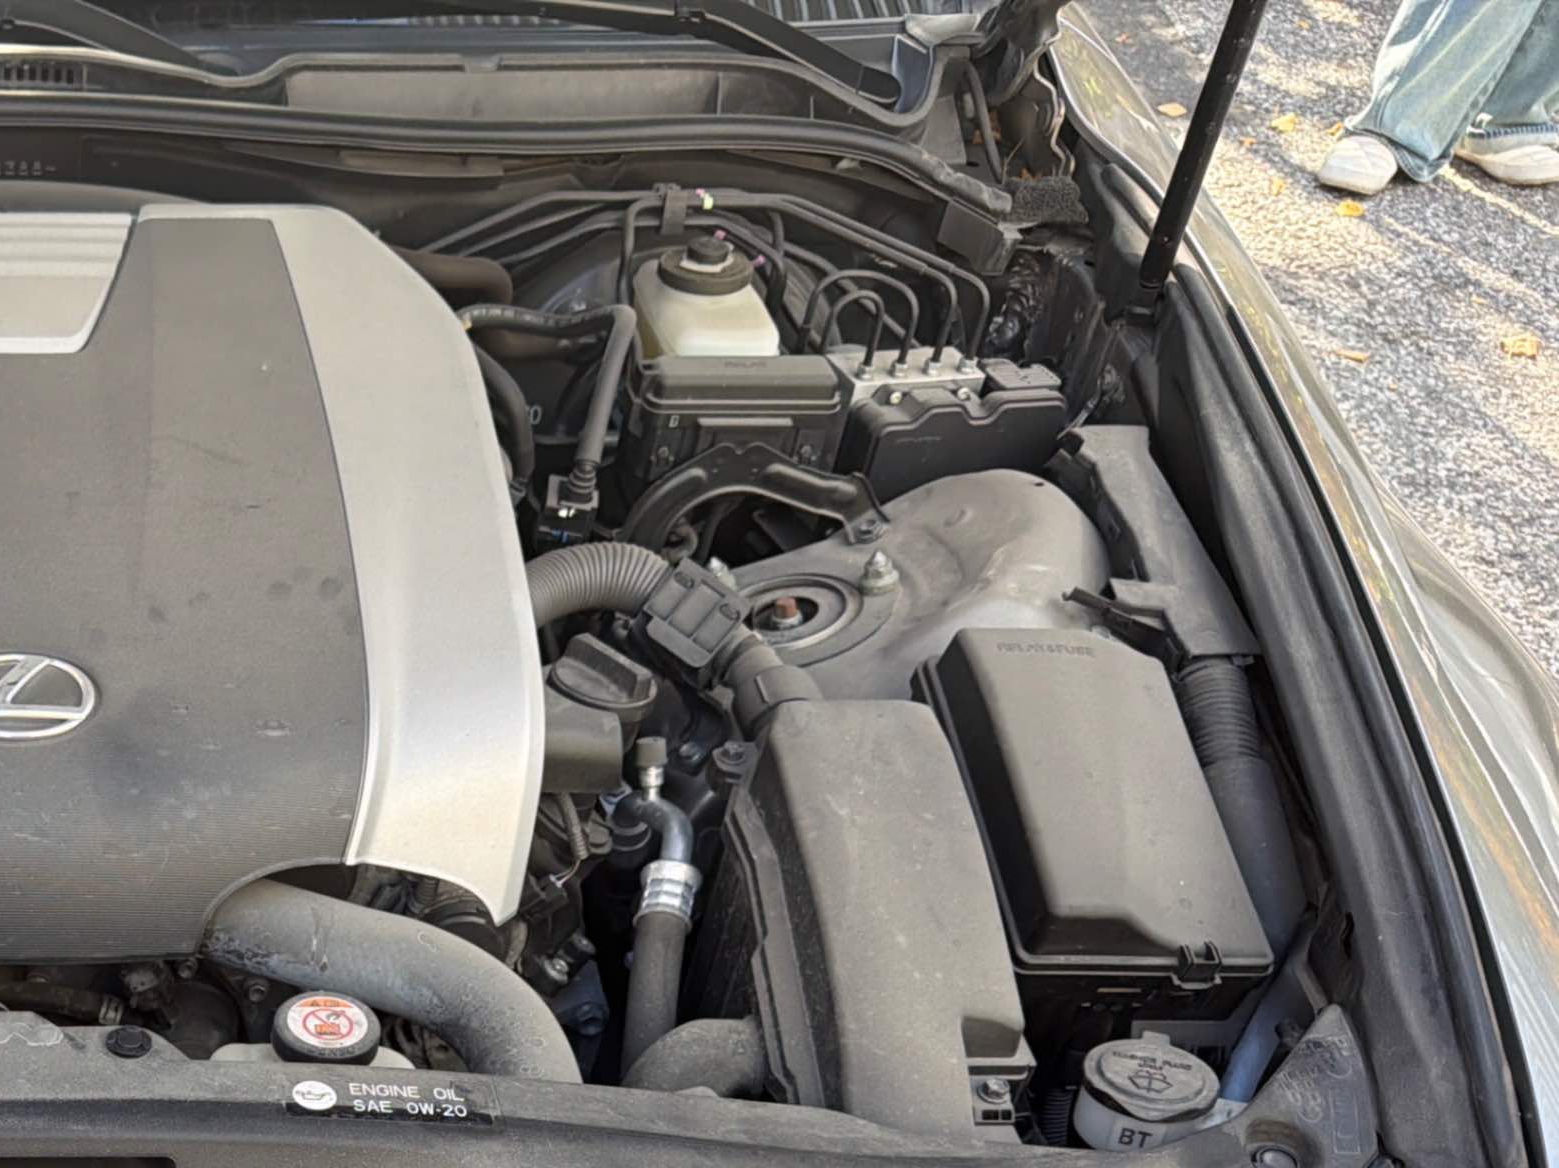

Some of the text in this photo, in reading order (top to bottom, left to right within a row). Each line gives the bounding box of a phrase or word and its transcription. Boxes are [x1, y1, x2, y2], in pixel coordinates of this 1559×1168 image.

[349, 1082, 465, 1102] ENGINE OIL
[353, 1099, 468, 1118] SAE 0W-20
[1118, 1127, 1154, 1148] BT
